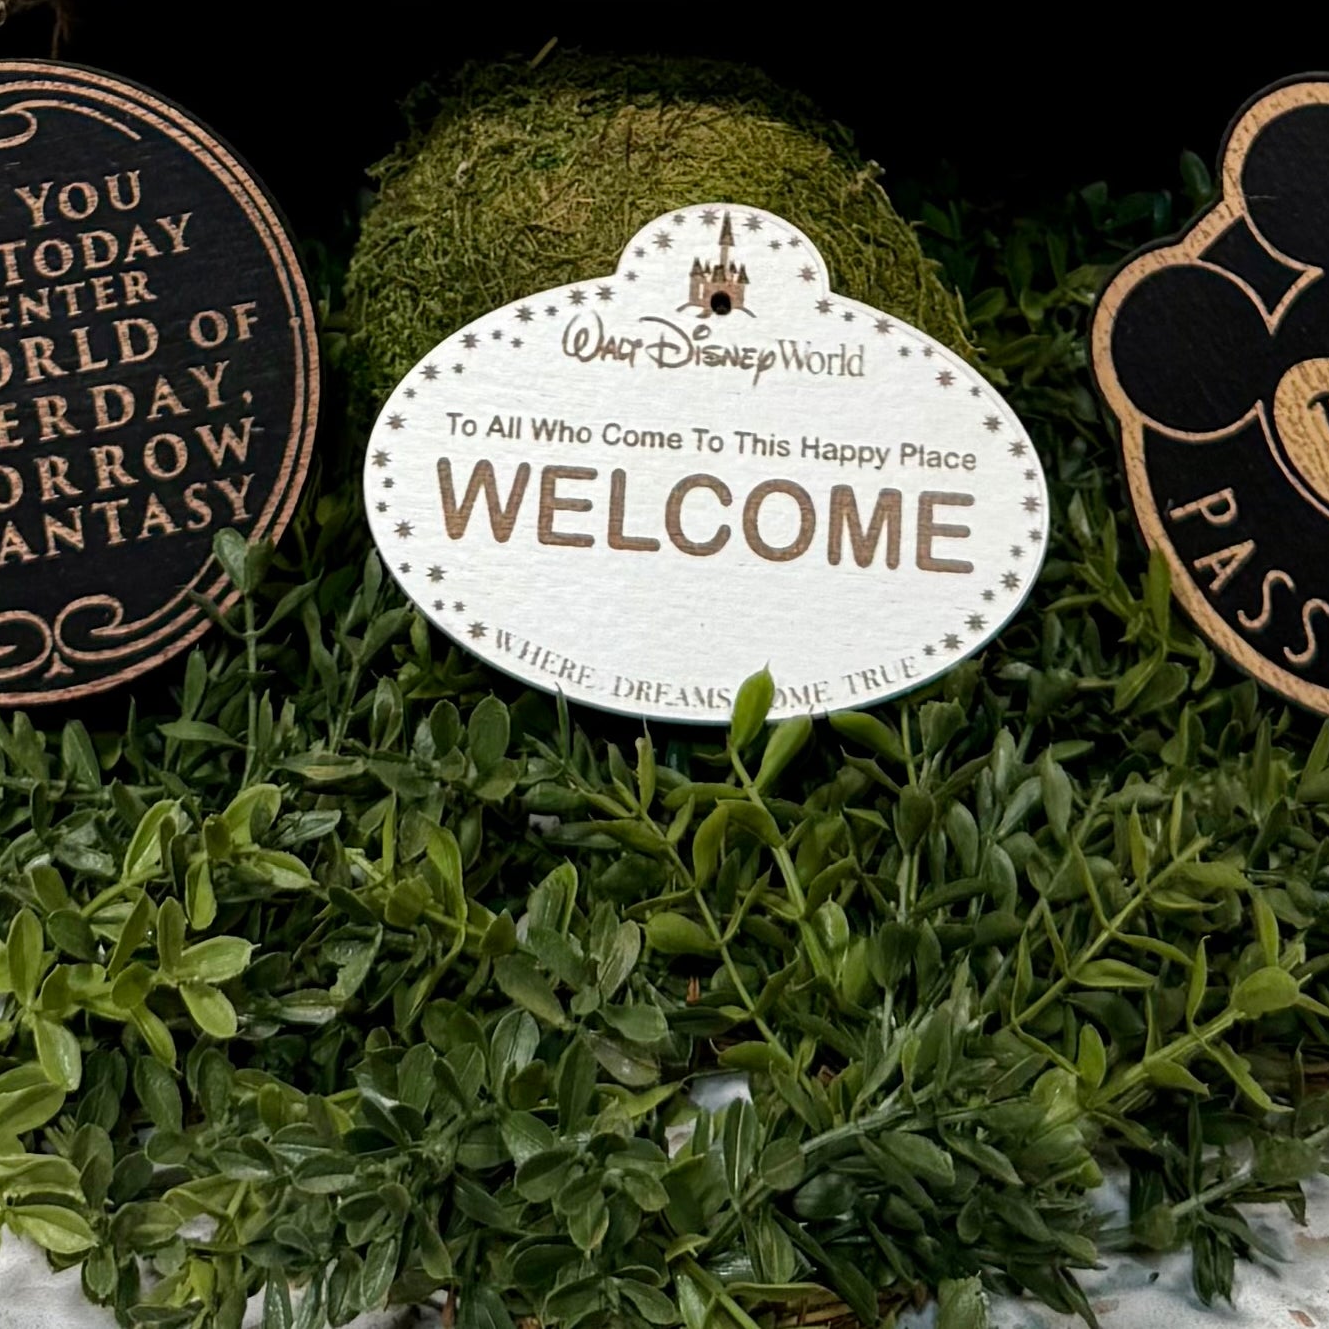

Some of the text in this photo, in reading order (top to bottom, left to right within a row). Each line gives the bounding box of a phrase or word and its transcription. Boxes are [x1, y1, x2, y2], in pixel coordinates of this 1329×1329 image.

[15, 170, 142, 229] YOU
[188, 302, 259, 350] OF
[778, 339, 866, 377] World
[446, 412, 977, 470] To All Who Come To This Happy Place
[436, 456, 976, 574] WELCOME
[495, 629, 921, 709] WHERE DREAMS OME TRUE
